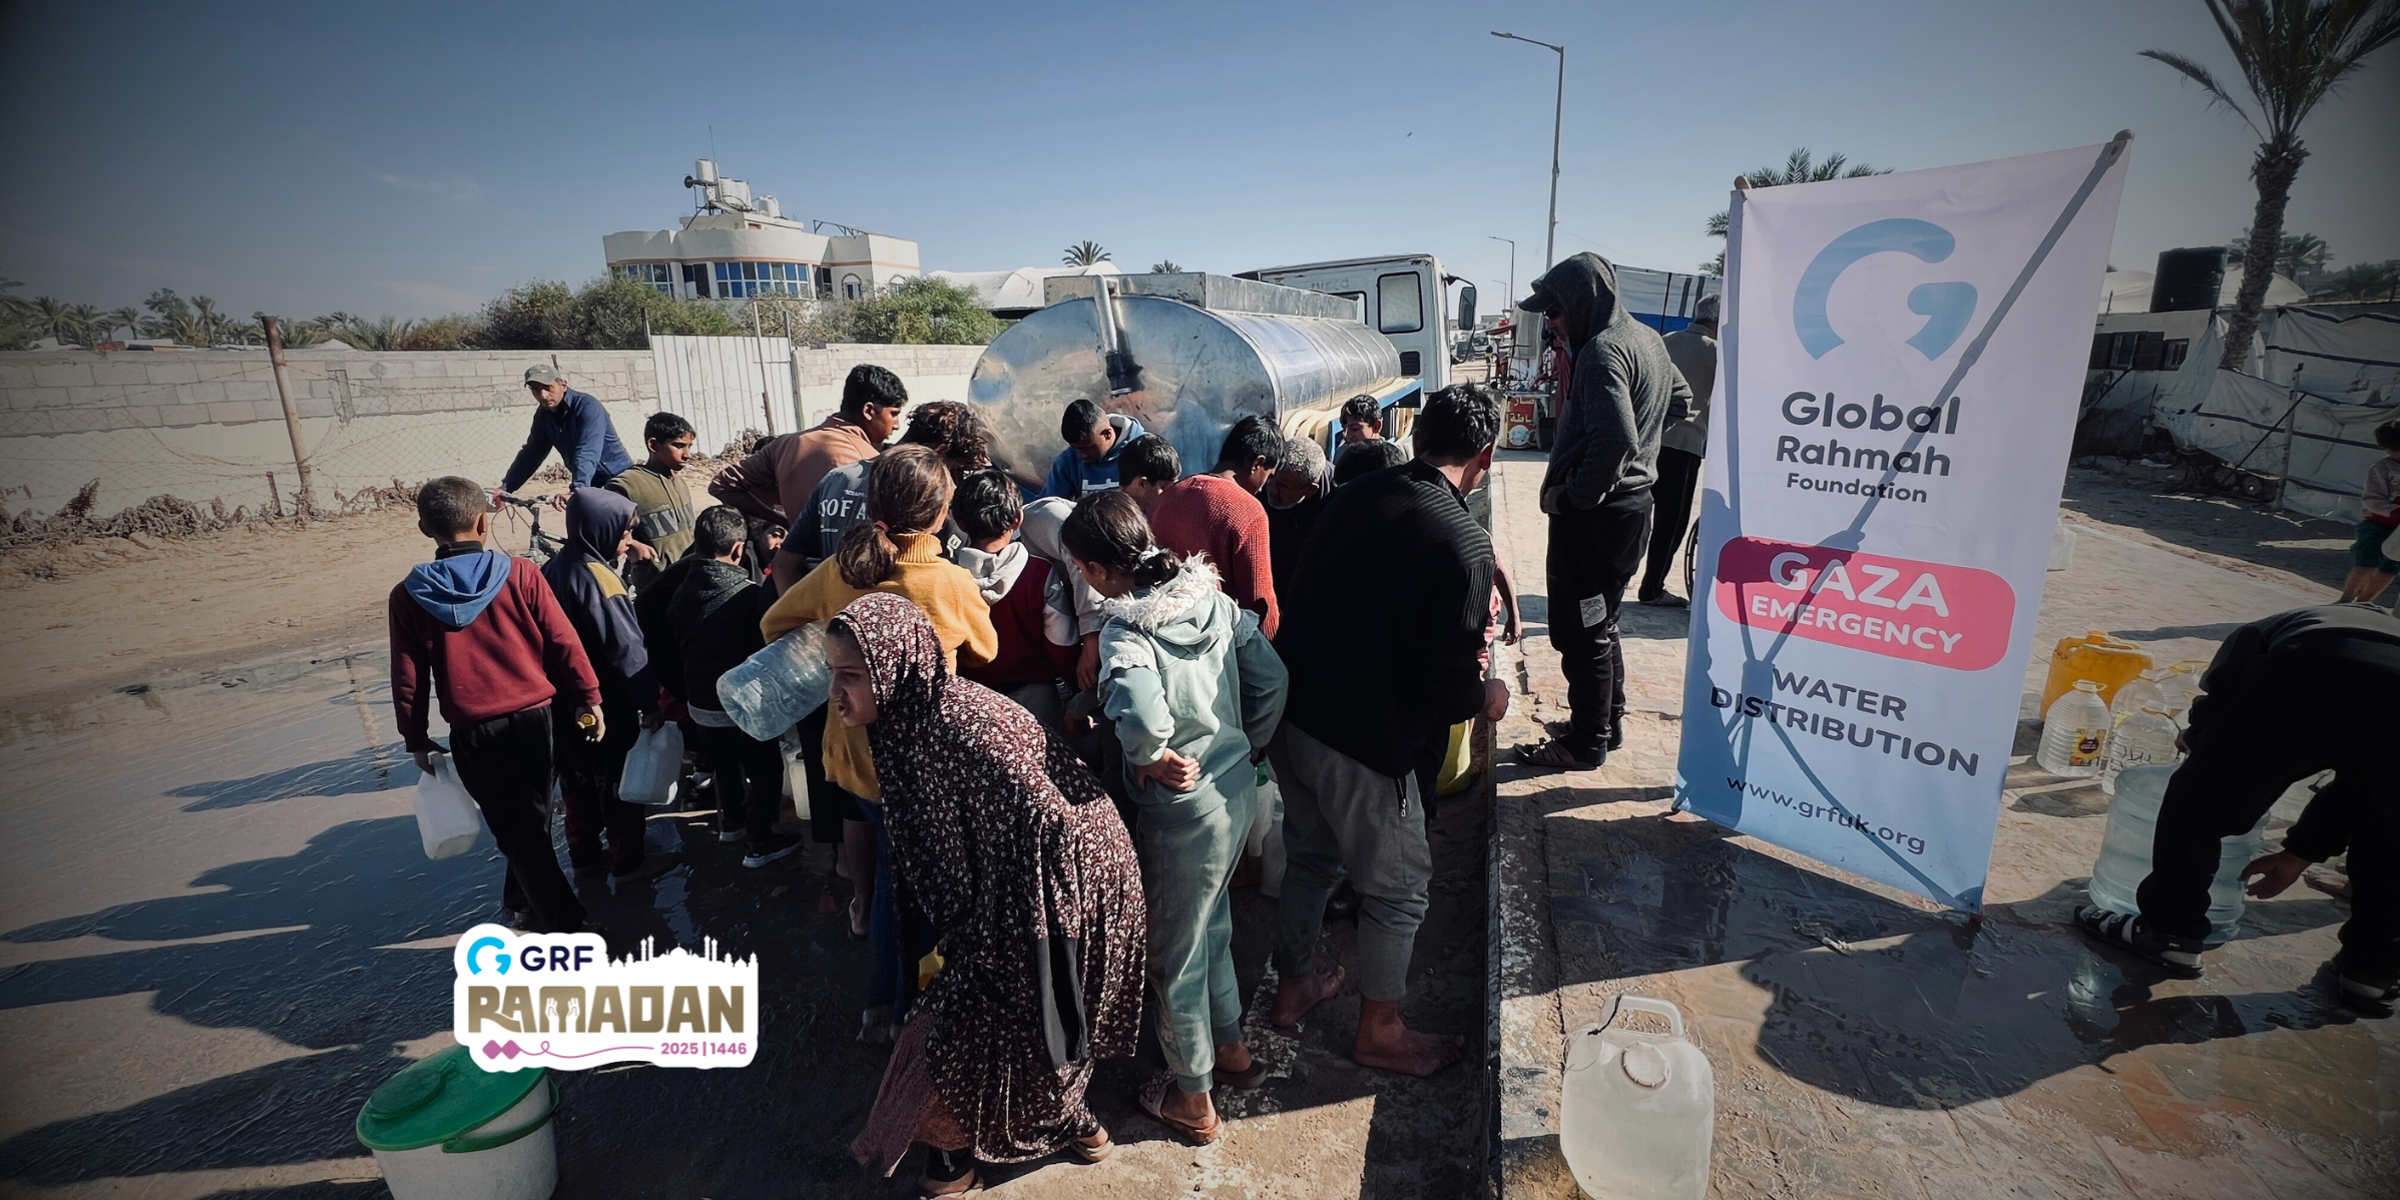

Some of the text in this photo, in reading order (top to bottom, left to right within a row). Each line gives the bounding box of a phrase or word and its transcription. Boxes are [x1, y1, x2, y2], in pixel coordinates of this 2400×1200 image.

[1781, 391, 1961, 435] Global
[1776, 435, 1951, 477] Rahmah
[1786, 472, 1928, 503] Foundation
[1769, 551, 1950, 619] GAZA
[1750, 595, 1963, 655] EMERGENCY
[1773, 668, 1907, 722] WATER
[1710, 686, 1979, 777] DISTRIBUTION
[1726, 776, 1926, 856] www.grfuk.org
